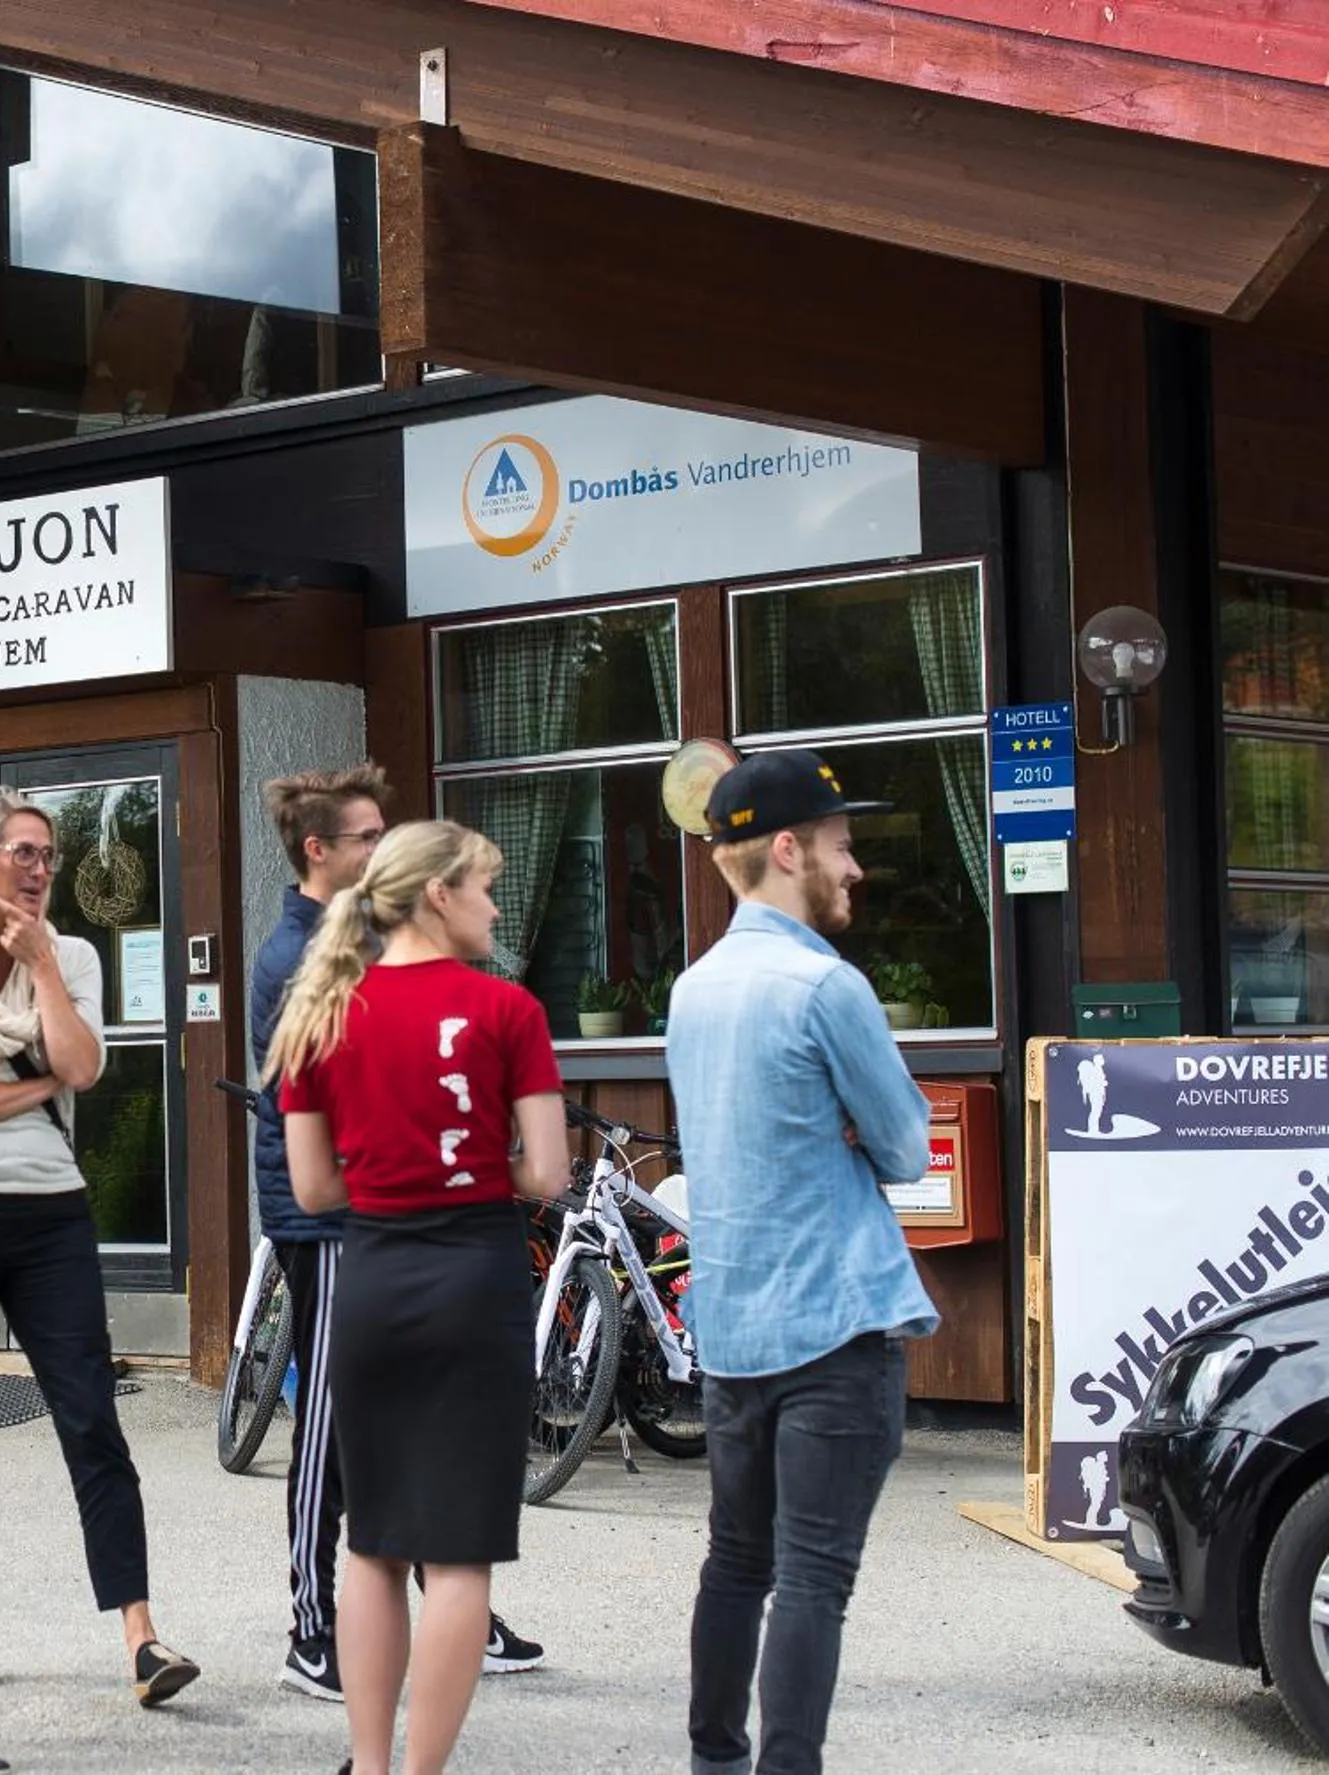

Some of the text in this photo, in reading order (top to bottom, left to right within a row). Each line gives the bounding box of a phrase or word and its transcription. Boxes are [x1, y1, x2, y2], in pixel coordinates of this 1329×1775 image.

[568, 443, 852, 504] Dombås Vandrerhjem
[1005, 709, 1061, 727] HOTELL
[1014, 766, 1053, 784] 2010
[1176, 1055, 1329, 1081] DOVREFJE
[1176, 1088, 1289, 1105] ADVENTURES
[1070, 1169, 1329, 1427] Sykkelutlei
